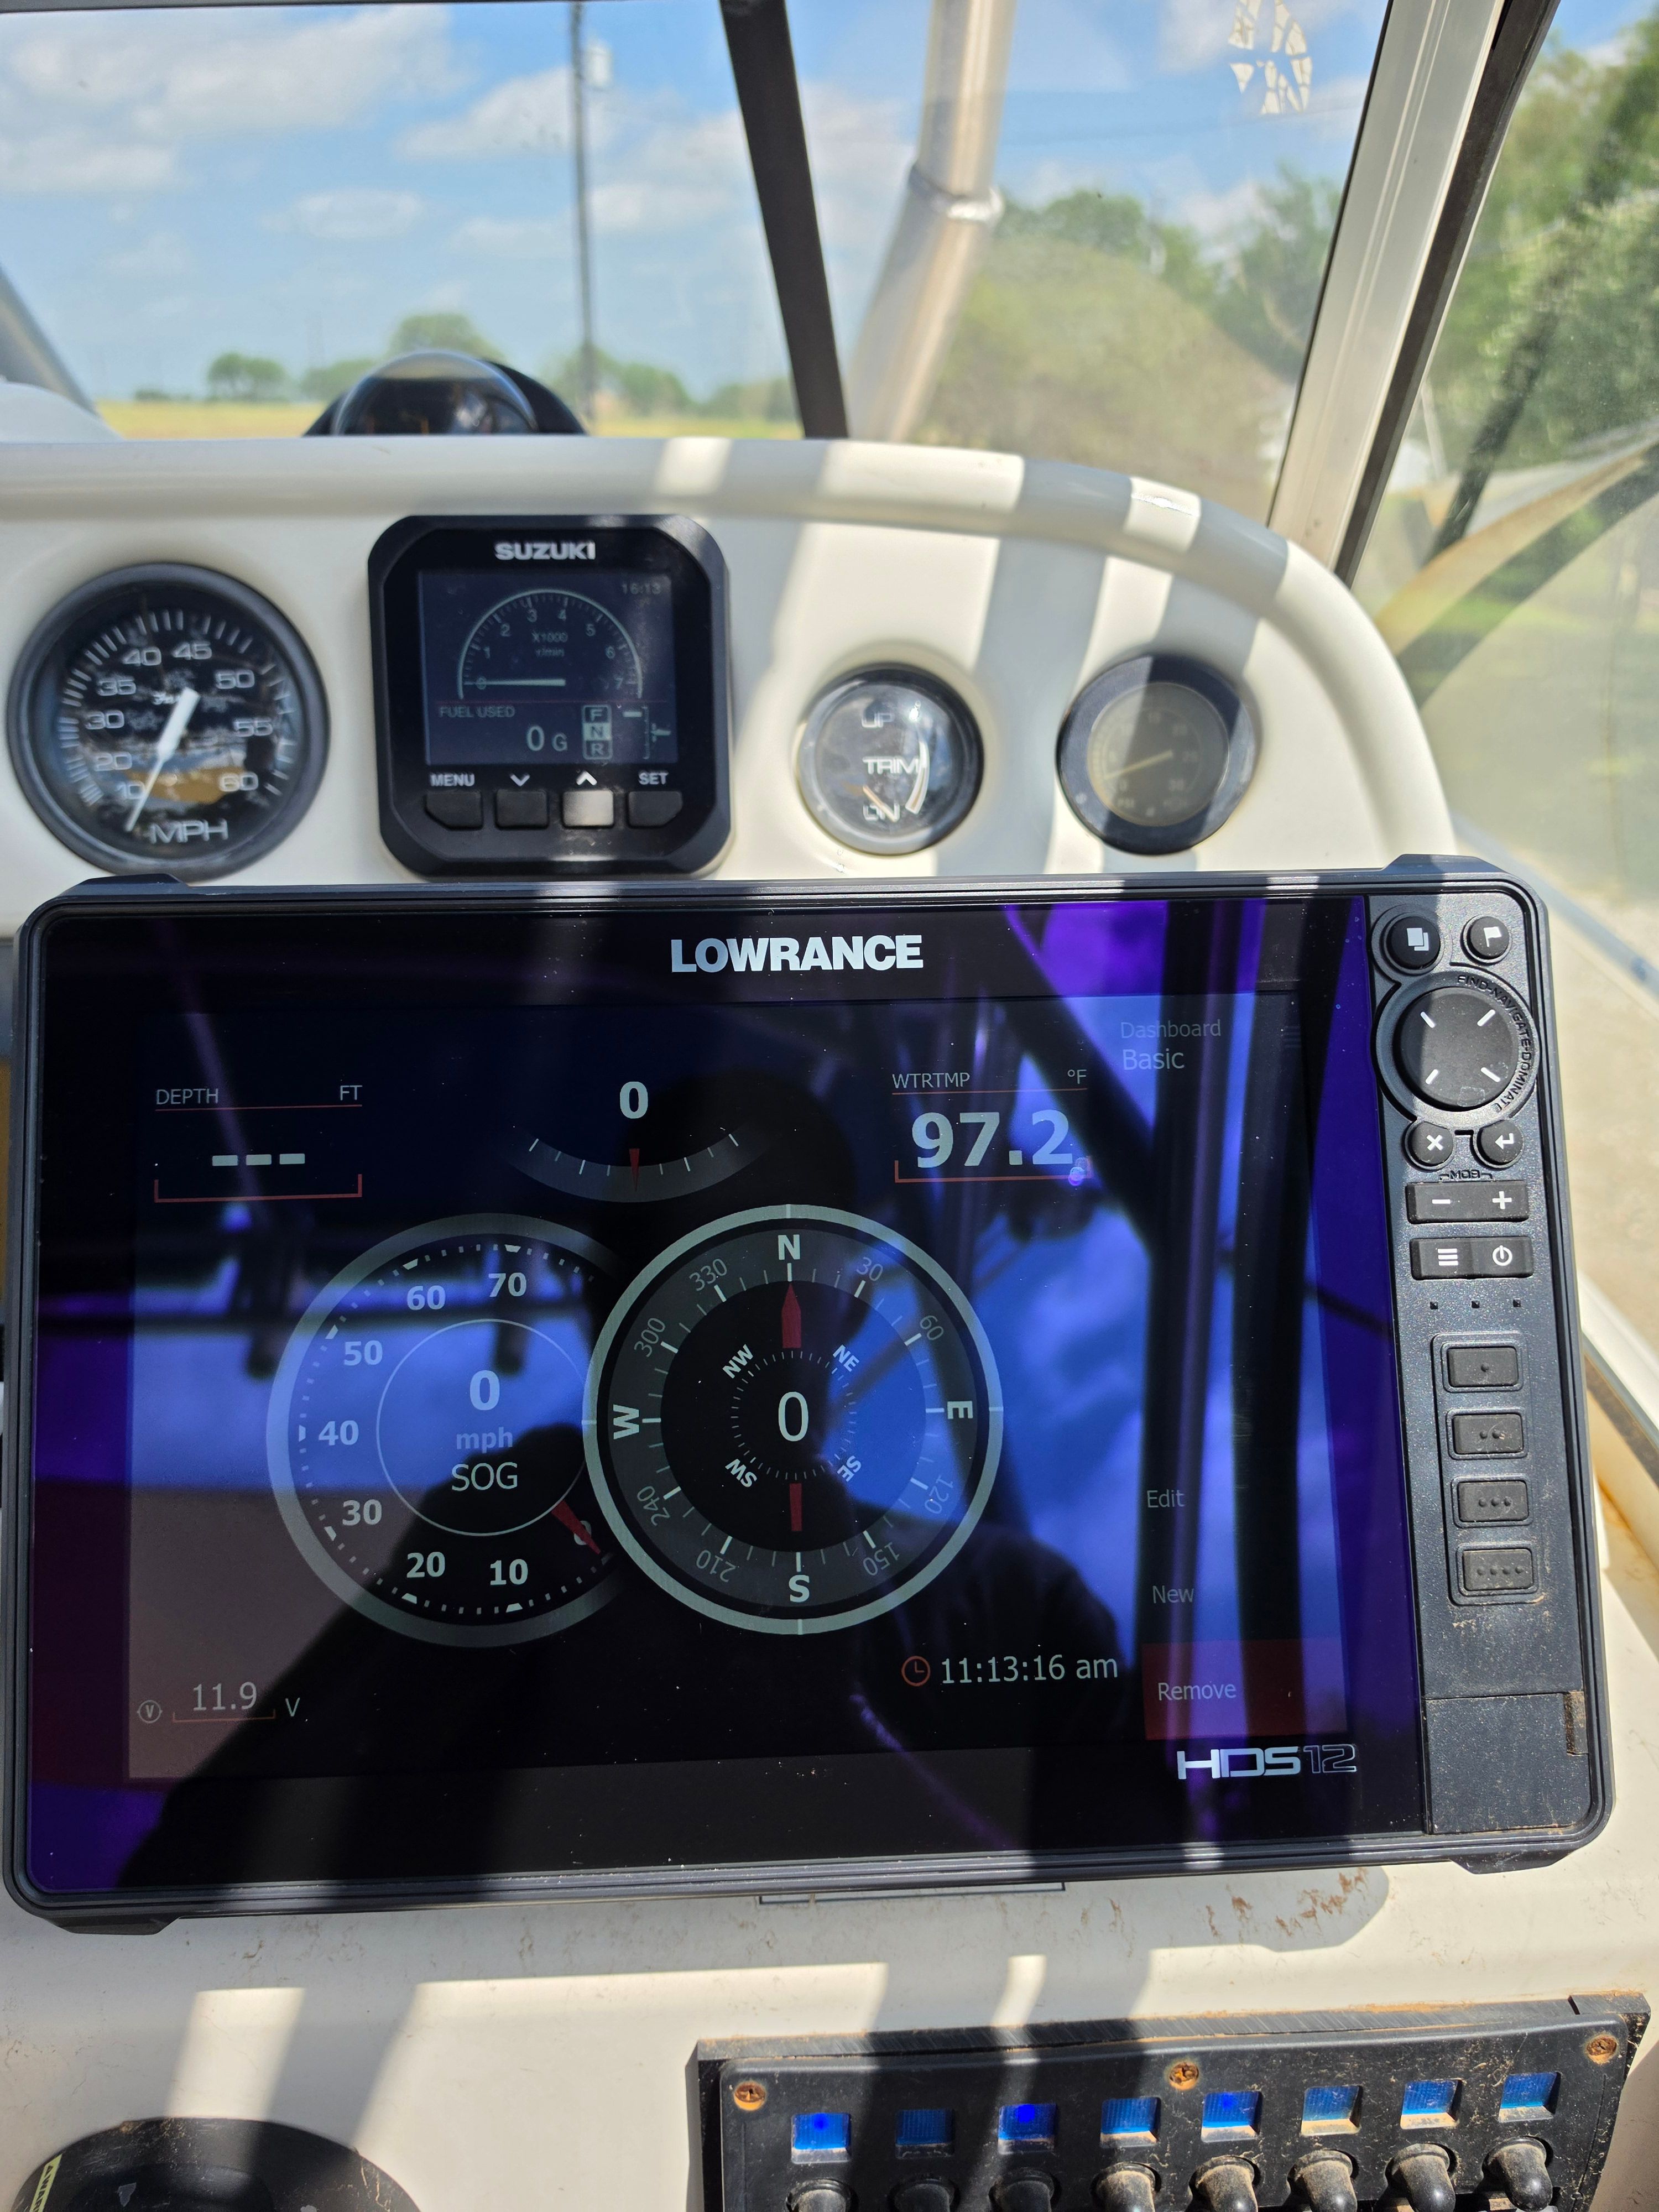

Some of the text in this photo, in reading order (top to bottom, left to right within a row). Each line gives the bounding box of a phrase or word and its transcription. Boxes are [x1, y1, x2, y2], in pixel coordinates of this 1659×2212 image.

[494, 541, 596, 560] SUZUKI
[527, 609, 538, 623] 3
[557, 609, 567, 621] 4
[500, 623, 512, 637] 2
[585, 623, 596, 637] 5
[123, 646, 161, 666] 40
[173, 641, 212, 660] 45
[482, 646, 491, 659] 1
[606, 646, 615, 659] 6
[96, 676, 137, 696] 35
[216, 670, 255, 690] 50
[614, 677, 624, 690] 7
[85, 709, 124, 729] 30
[440, 705, 515, 718] FUEL USED
[590, 708, 602, 721] F
[861, 712, 894, 728] UP
[233, 719, 273, 737] 55
[591, 726, 602, 738] N
[526, 725, 568, 752] 0 G
[591, 743, 603, 755] R
[94, 752, 132, 770] 20
[862, 757, 920, 774] TRIM
[218, 773, 258, 792] 60
[431, 773, 475, 787] MENU
[638, 773, 669, 785] SET
[114, 781, 145, 800] 10
[149, 820, 228, 844] MPH
[671, 935, 924, 973] LOWRANCE
[1121, 1019, 1221, 1039] Dashboard
[1123, 1048, 1185, 1070] Basic
[893, 1072, 970, 1088] WTRTMP
[1068, 1070, 1087, 1084] °F
[156, 1089, 218, 1105] DEPTH
[340, 1085, 363, 1100] FT
[620, 1081, 648, 1119] 0
[912, 1110, 1073, 1168] 97.2
[778, 1234, 800, 1260] N
[688, 1258, 728, 1292] 330
[855, 1256, 884, 1282] 30
[488, 1272, 527, 1298] 70
[406, 1285, 446, 1311] 60
[920, 1314, 945, 1340] 60
[634, 1317, 666, 1358] 300
[344, 1340, 383, 1366] 50
[722, 1344, 754, 1379] NW
[832, 1344, 860, 1372] NE
[469, 1369, 500, 1411] 0
[778, 1391, 809, 1442] 0
[947, 1400, 973, 1420] E
[613, 1404, 640, 1440] W
[319, 1420, 359, 1447] 40
[456, 1427, 514, 1453] mph
[451, 1463, 518, 1492] SOG
[725, 1458, 758, 1488] SW
[837, 1455, 862, 1481] SE
[924, 1474, 954, 1515] 120
[1146, 1489, 1186, 1508] Edit
[342, 1499, 383, 1526] 30
[637, 1485, 670, 1527] 240
[406, 1552, 446, 1579] 20
[696, 1549, 738, 1583] 210
[863, 1542, 900, 1577] 150
[489, 1558, 529, 1587] 10
[789, 1575, 810, 1603] S
[1152, 1585, 1194, 1604] New
[942, 1654, 1118, 1684] 11:13:16 am
[193, 1681, 257, 1712] 11.9
[1158, 1682, 1237, 1701] Remove
[285, 1697, 300, 1717] V
